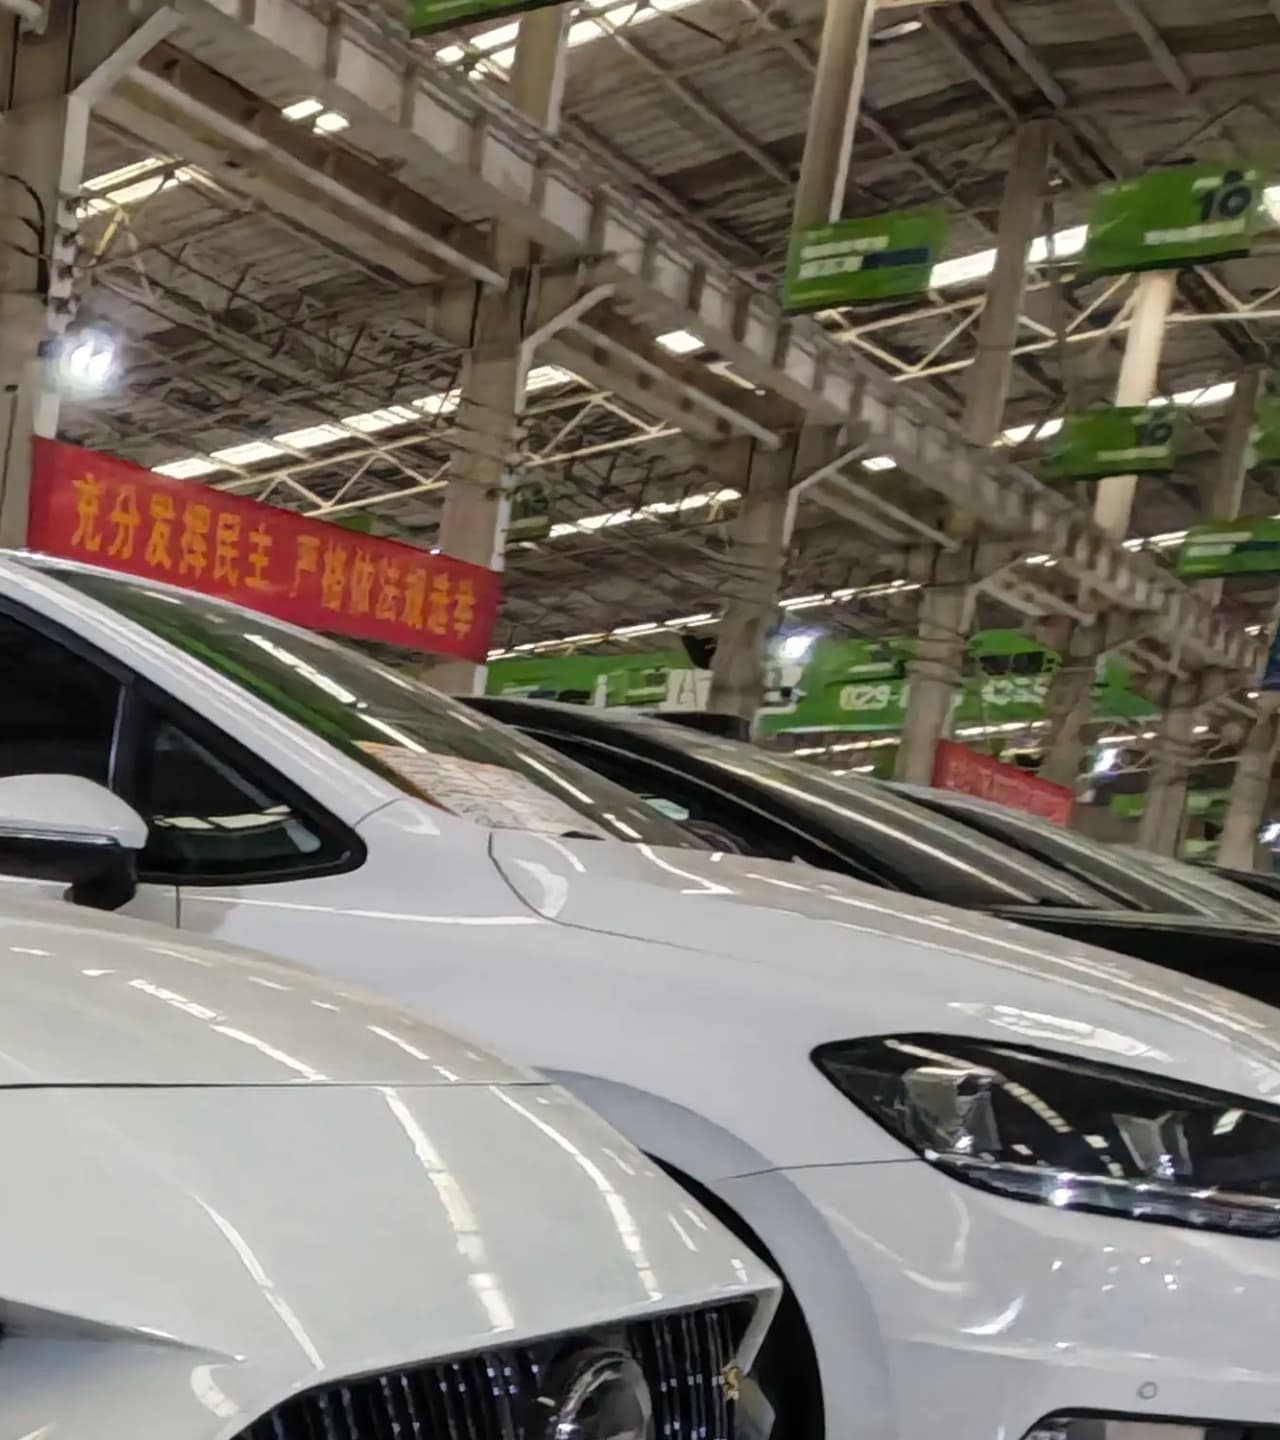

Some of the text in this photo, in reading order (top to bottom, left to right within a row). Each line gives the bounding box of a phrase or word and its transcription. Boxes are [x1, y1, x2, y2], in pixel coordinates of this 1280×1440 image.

[70, 472, 274, 593] 充分发挥民主
